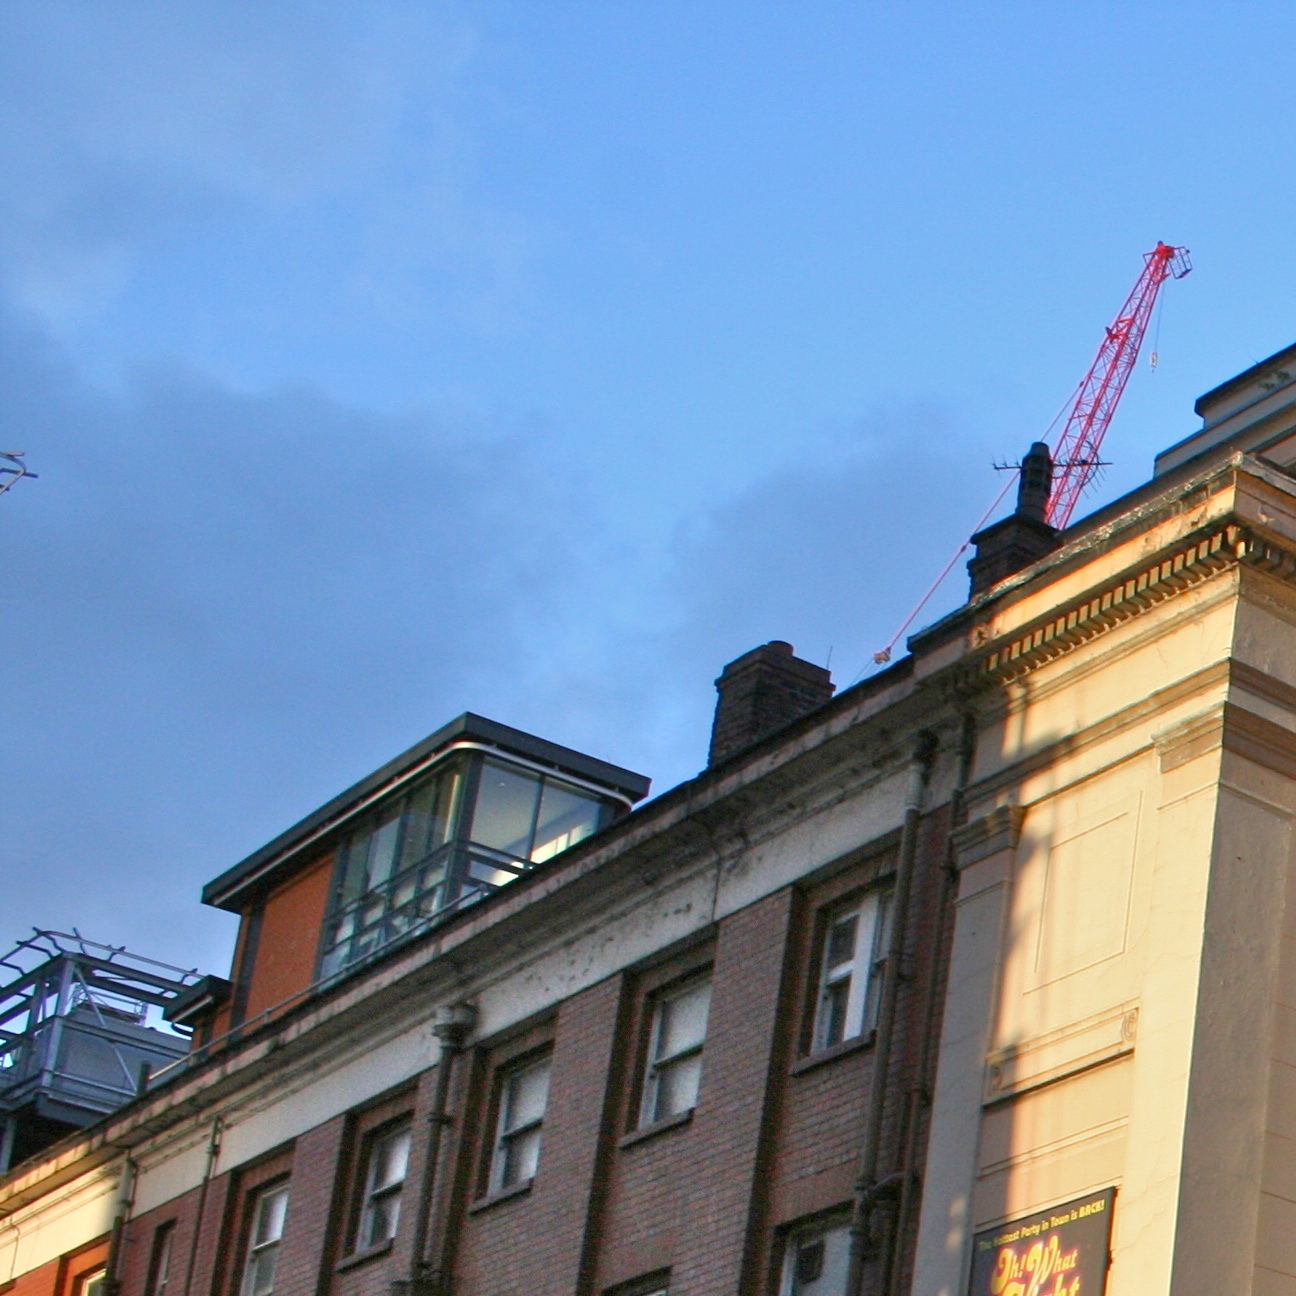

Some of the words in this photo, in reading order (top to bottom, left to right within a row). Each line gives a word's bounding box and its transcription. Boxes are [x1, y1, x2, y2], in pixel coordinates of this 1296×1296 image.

[1021, 1223, 1040, 1238] Party
[1041, 1220, 1050, 1231] in
[1050, 1214, 1070, 1228] Town
[1071, 1209, 1078, 1220] is
[1079, 1199, 1106, 1218] BACK!
[991, 1248, 1027, 1295] Oh!
[1026, 1235, 1079, 1285] What
